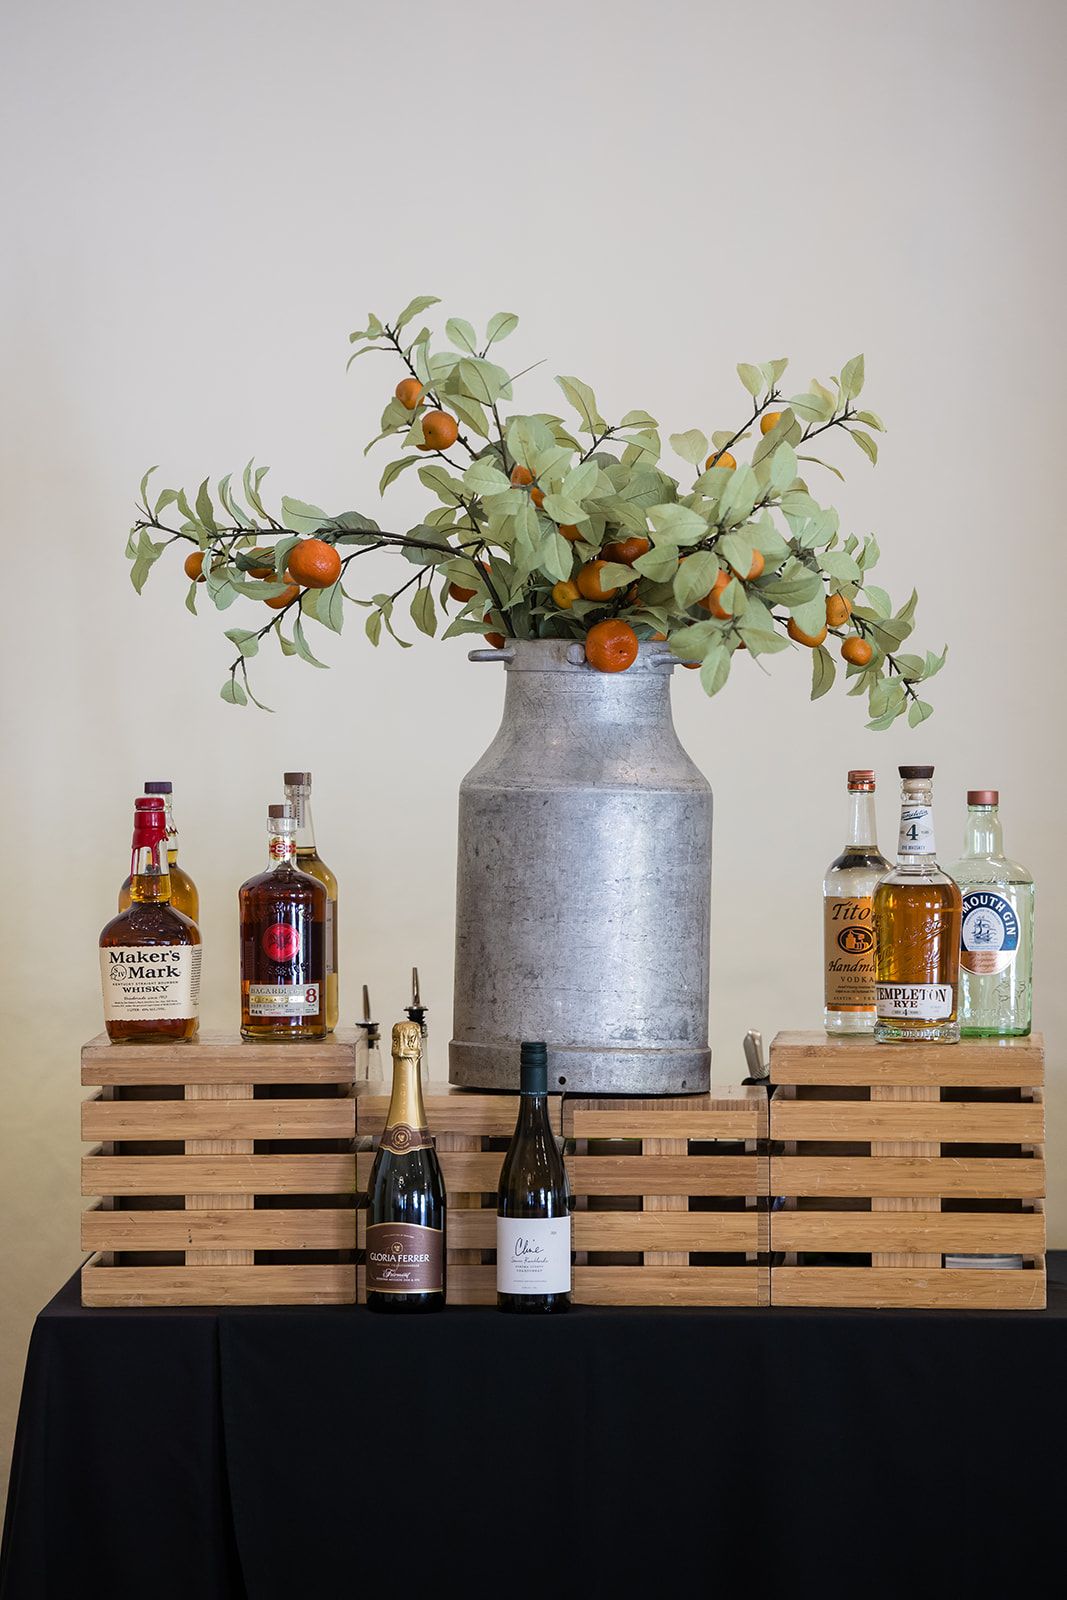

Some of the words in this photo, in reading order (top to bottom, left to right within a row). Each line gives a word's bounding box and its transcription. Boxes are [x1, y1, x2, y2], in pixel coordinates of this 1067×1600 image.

[906, 824, 919, 841] 4
[961, 894, 1006, 917] MOUTH
[1002, 911, 1017, 935] GIN
[109, 950, 181, 964] Maker's
[128, 965, 180, 979] Mark
[122, 985, 169, 993] WHISKY
[305, 987, 317, 1004] 8
[893, 1000, 918, 1008] RYE
[369, 1252, 397, 1263] GLORIA
[397, 1253, 430, 1263] FERRER
